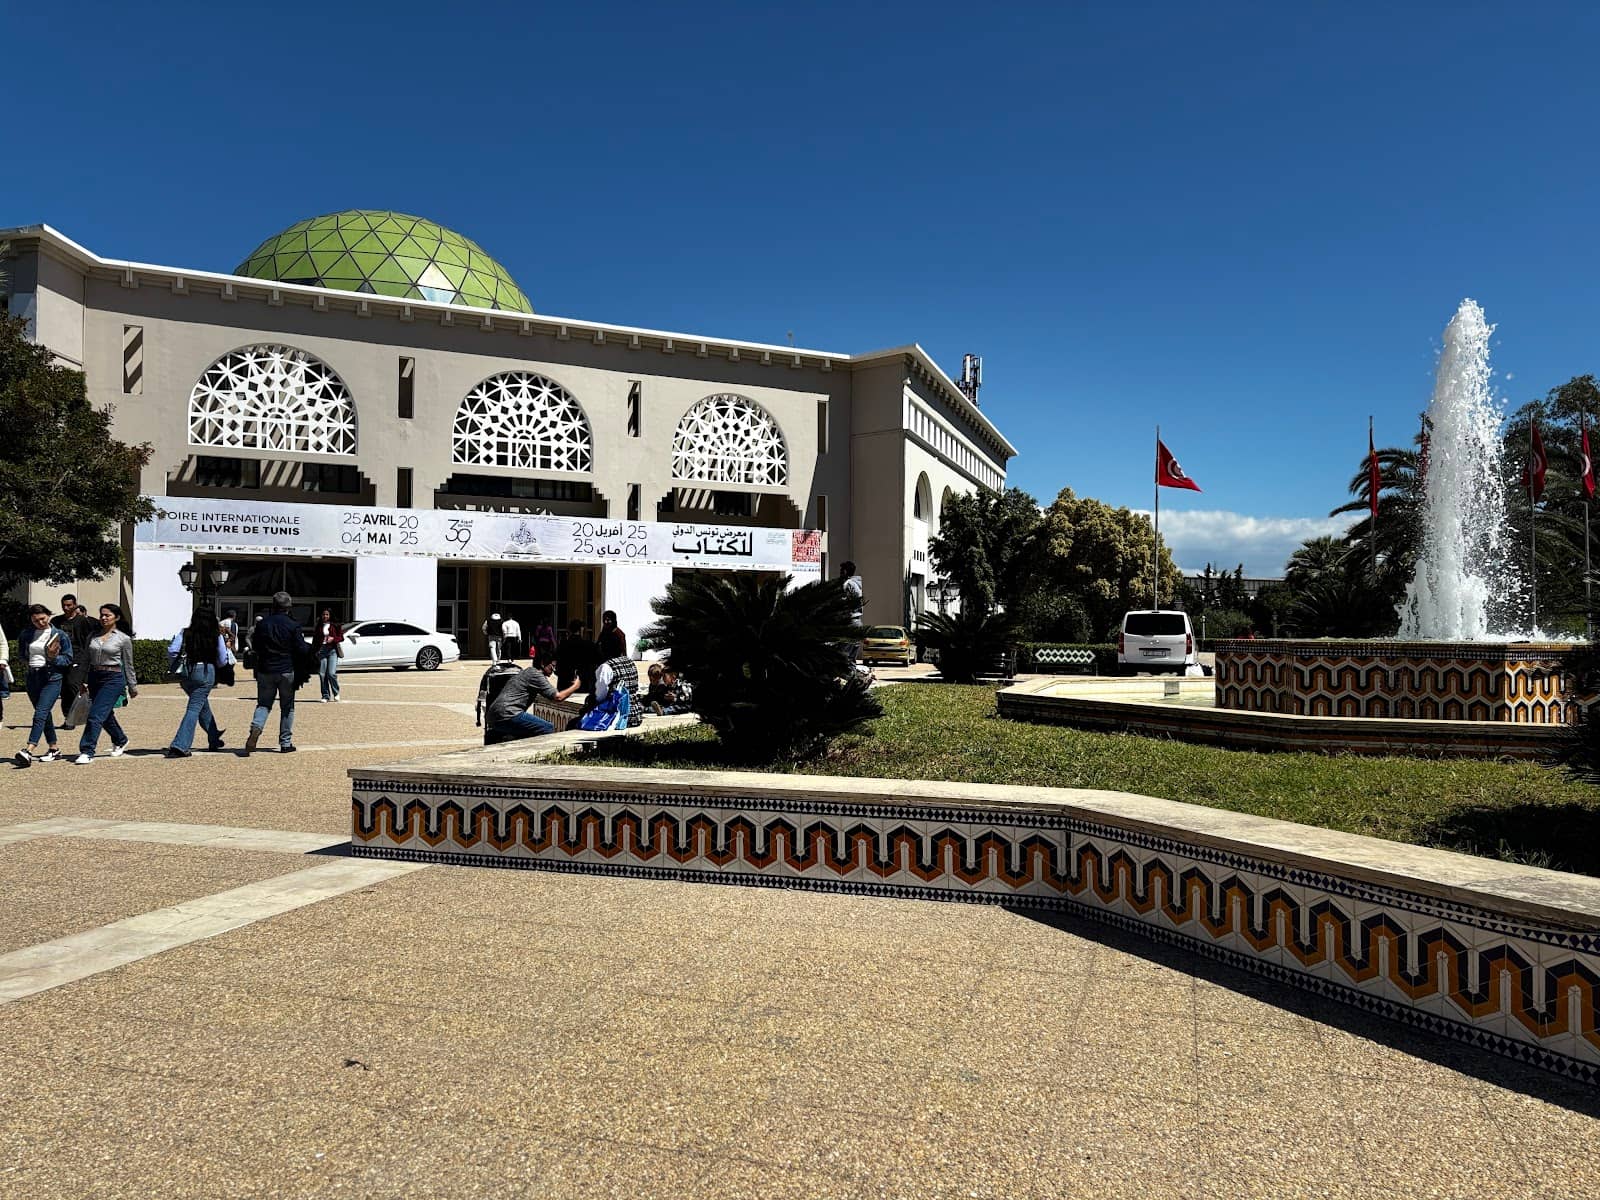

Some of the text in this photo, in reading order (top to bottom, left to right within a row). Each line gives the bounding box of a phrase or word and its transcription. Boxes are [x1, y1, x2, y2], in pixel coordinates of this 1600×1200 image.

[164, 511, 300, 525] OIRE INTERNATIONALE
[343, 512, 419, 529] 25 AVRIL 20
[180, 523, 300, 536] DU LIVRE DE TUNIS
[341, 530, 419, 545] 04 MAI 25
[445, 519, 472, 551] 39
[572, 521, 648, 540] 25 أفريل 20
[672, 524, 747, 539] معرض تونس الدولي
[573, 538, 648, 558] 04 ماي 25
[672, 531, 753, 560] للكتاب
